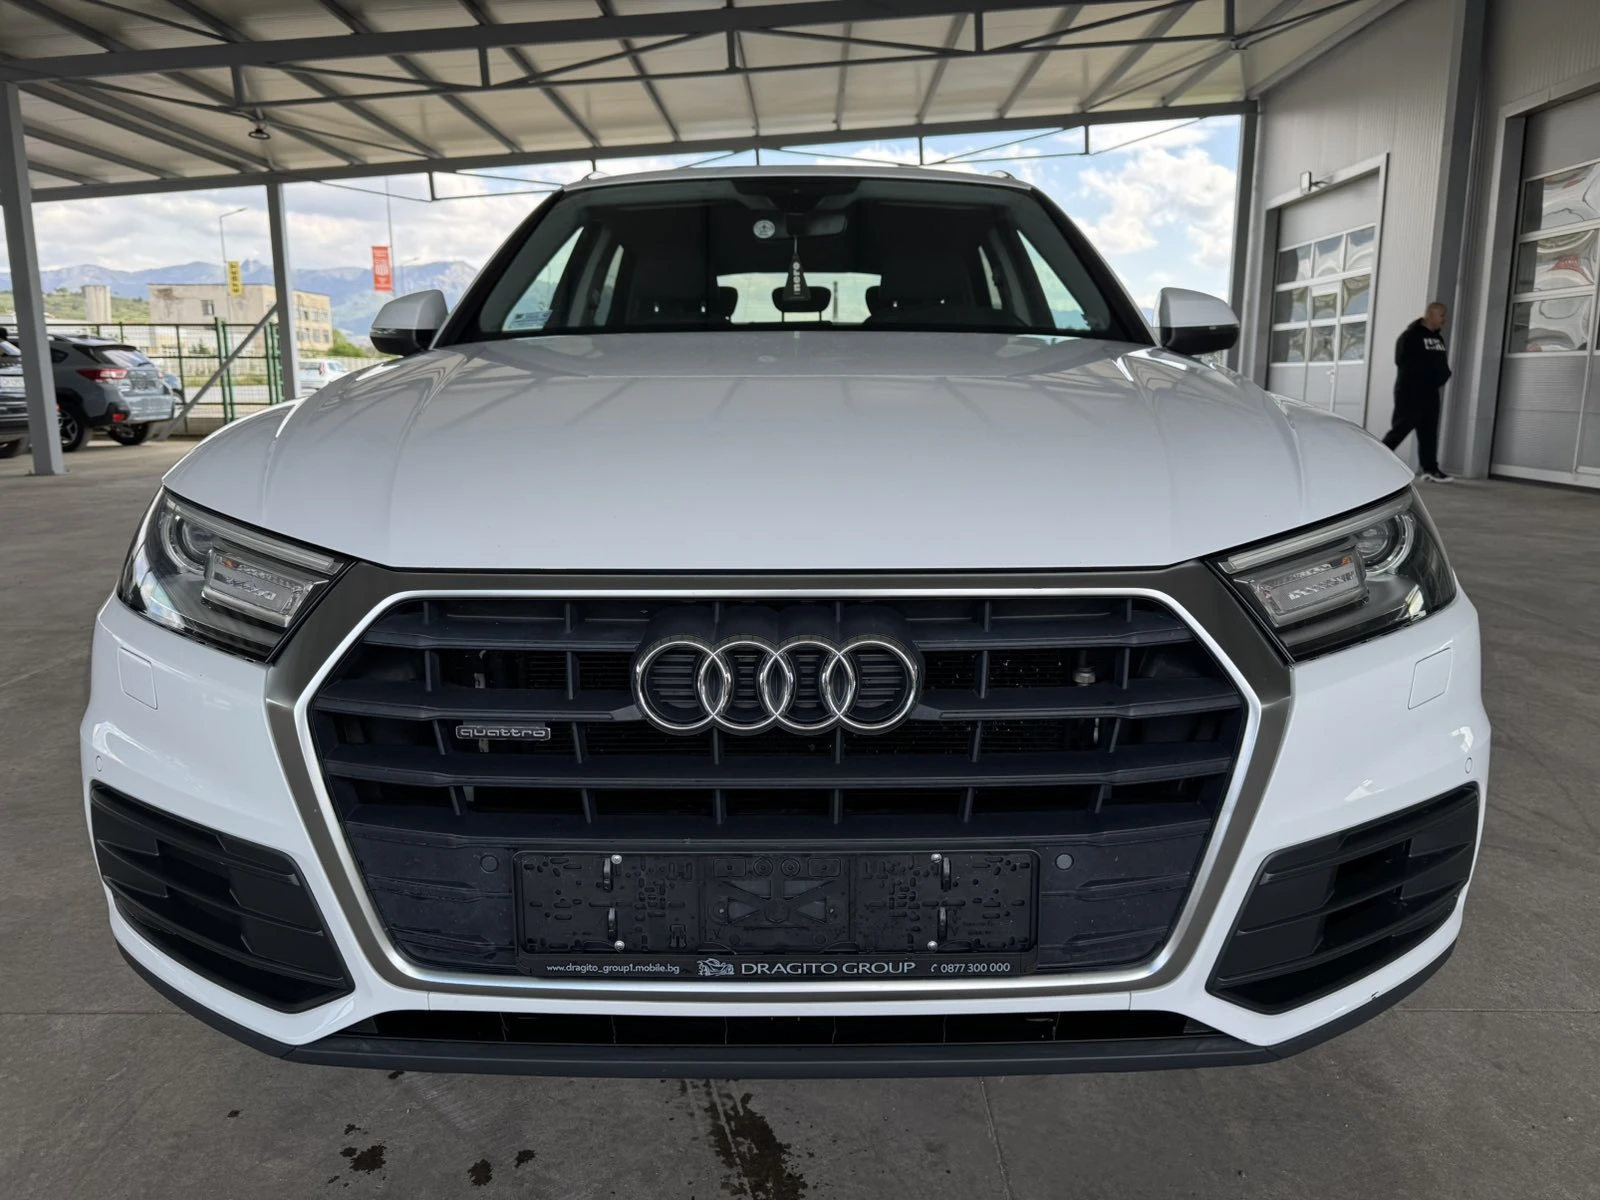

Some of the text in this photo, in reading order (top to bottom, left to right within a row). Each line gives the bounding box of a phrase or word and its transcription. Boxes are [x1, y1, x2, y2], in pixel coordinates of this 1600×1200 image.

[459, 728, 546, 738] quattro
[546, 963, 680, 974] www.dragito_group1.mobile.bg
[741, 962, 916, 975] DRAGITO GROUP
[940, 962, 1011, 973] 0877 300 000
